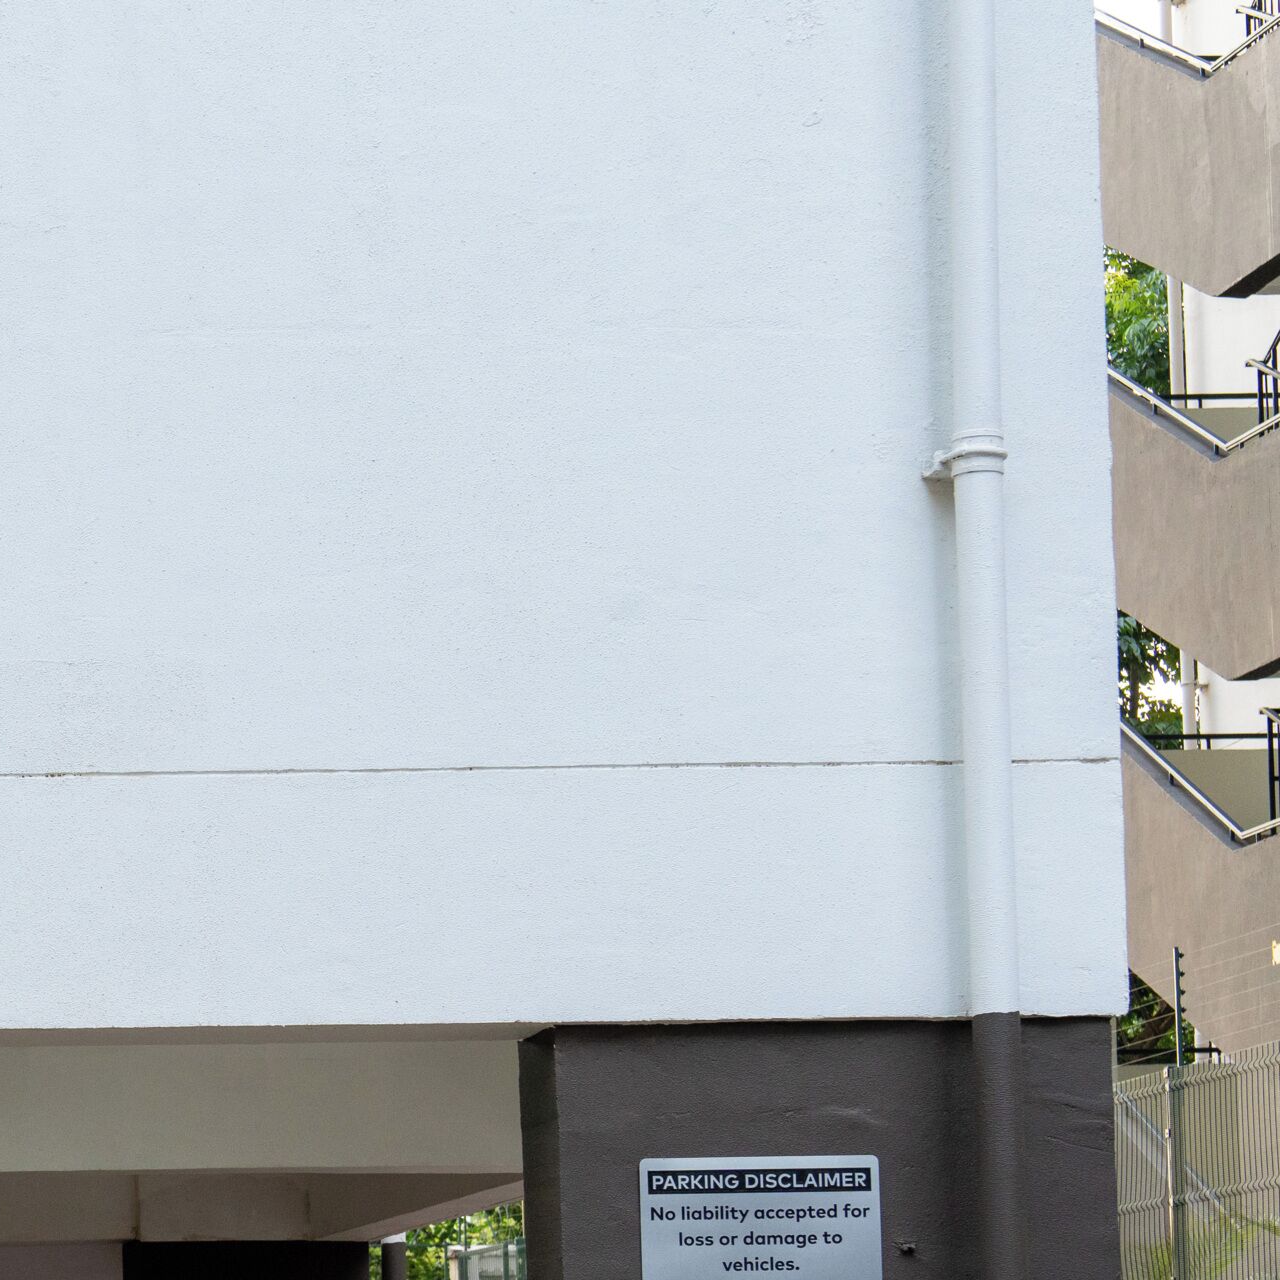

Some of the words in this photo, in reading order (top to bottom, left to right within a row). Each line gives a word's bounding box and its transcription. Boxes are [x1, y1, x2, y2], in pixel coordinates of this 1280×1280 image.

[652, 1174, 740, 1190] PARKING
[744, 1172, 867, 1189] DISCLAIMER
[650, 1206, 676, 1221] No
[681, 1205, 750, 1224] liability
[753, 1203, 838, 1223] accepted
[842, 1203, 871, 1218] for
[678, 1231, 714, 1247] loss
[719, 1235, 739, 1246] or
[743, 1230, 818, 1249] damage
[822, 1231, 843, 1245] to
[722, 1256, 800, 1272] vehicles.
